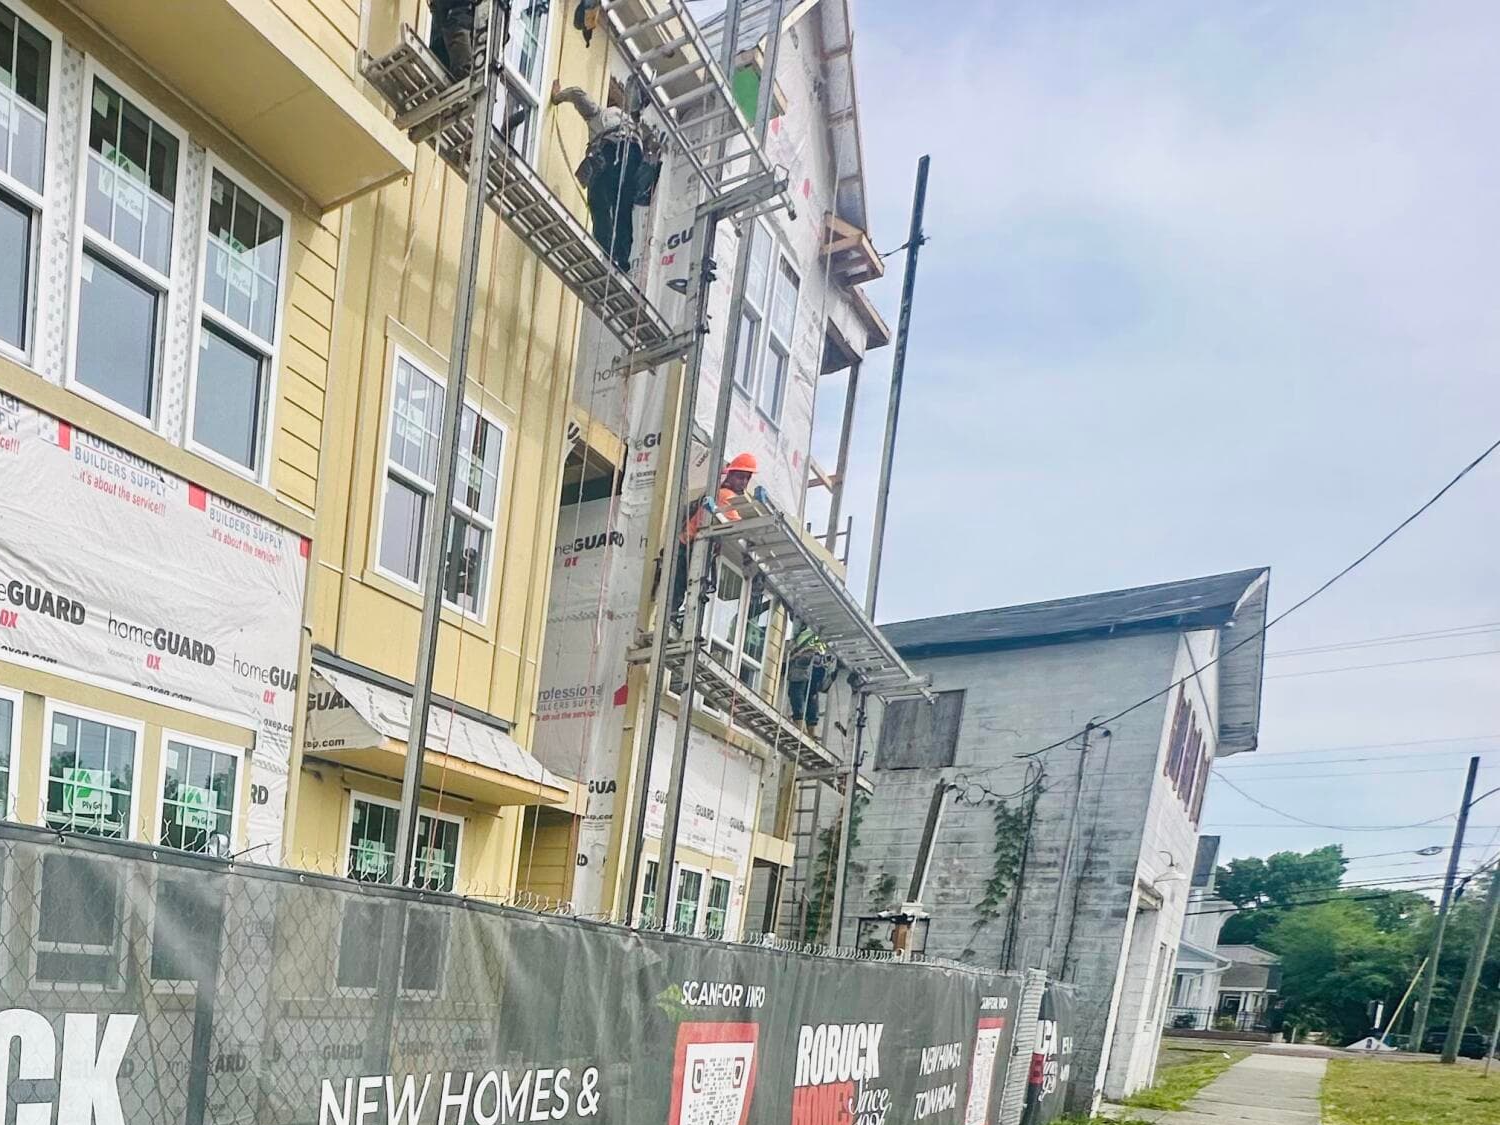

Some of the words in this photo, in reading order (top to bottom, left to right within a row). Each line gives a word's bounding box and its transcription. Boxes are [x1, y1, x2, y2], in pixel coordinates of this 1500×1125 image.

[75, 446, 127, 481] BUILDERS
[130, 470, 167, 498] SUPPLY
[93, 476, 117, 496] about
[118, 485, 131, 500] the
[209, 508, 251, 536] BUILDERS
[107, 610, 216, 667] homeGUARD
[145, 654, 162, 670] OX
[263, 689, 276, 704] OX
[744, 984, 766, 1009] INFO
[794, 1022, 884, 1087] ROBUCK
[576, 1065, 601, 1117] &
[848, 1068, 892, 1115] Since
